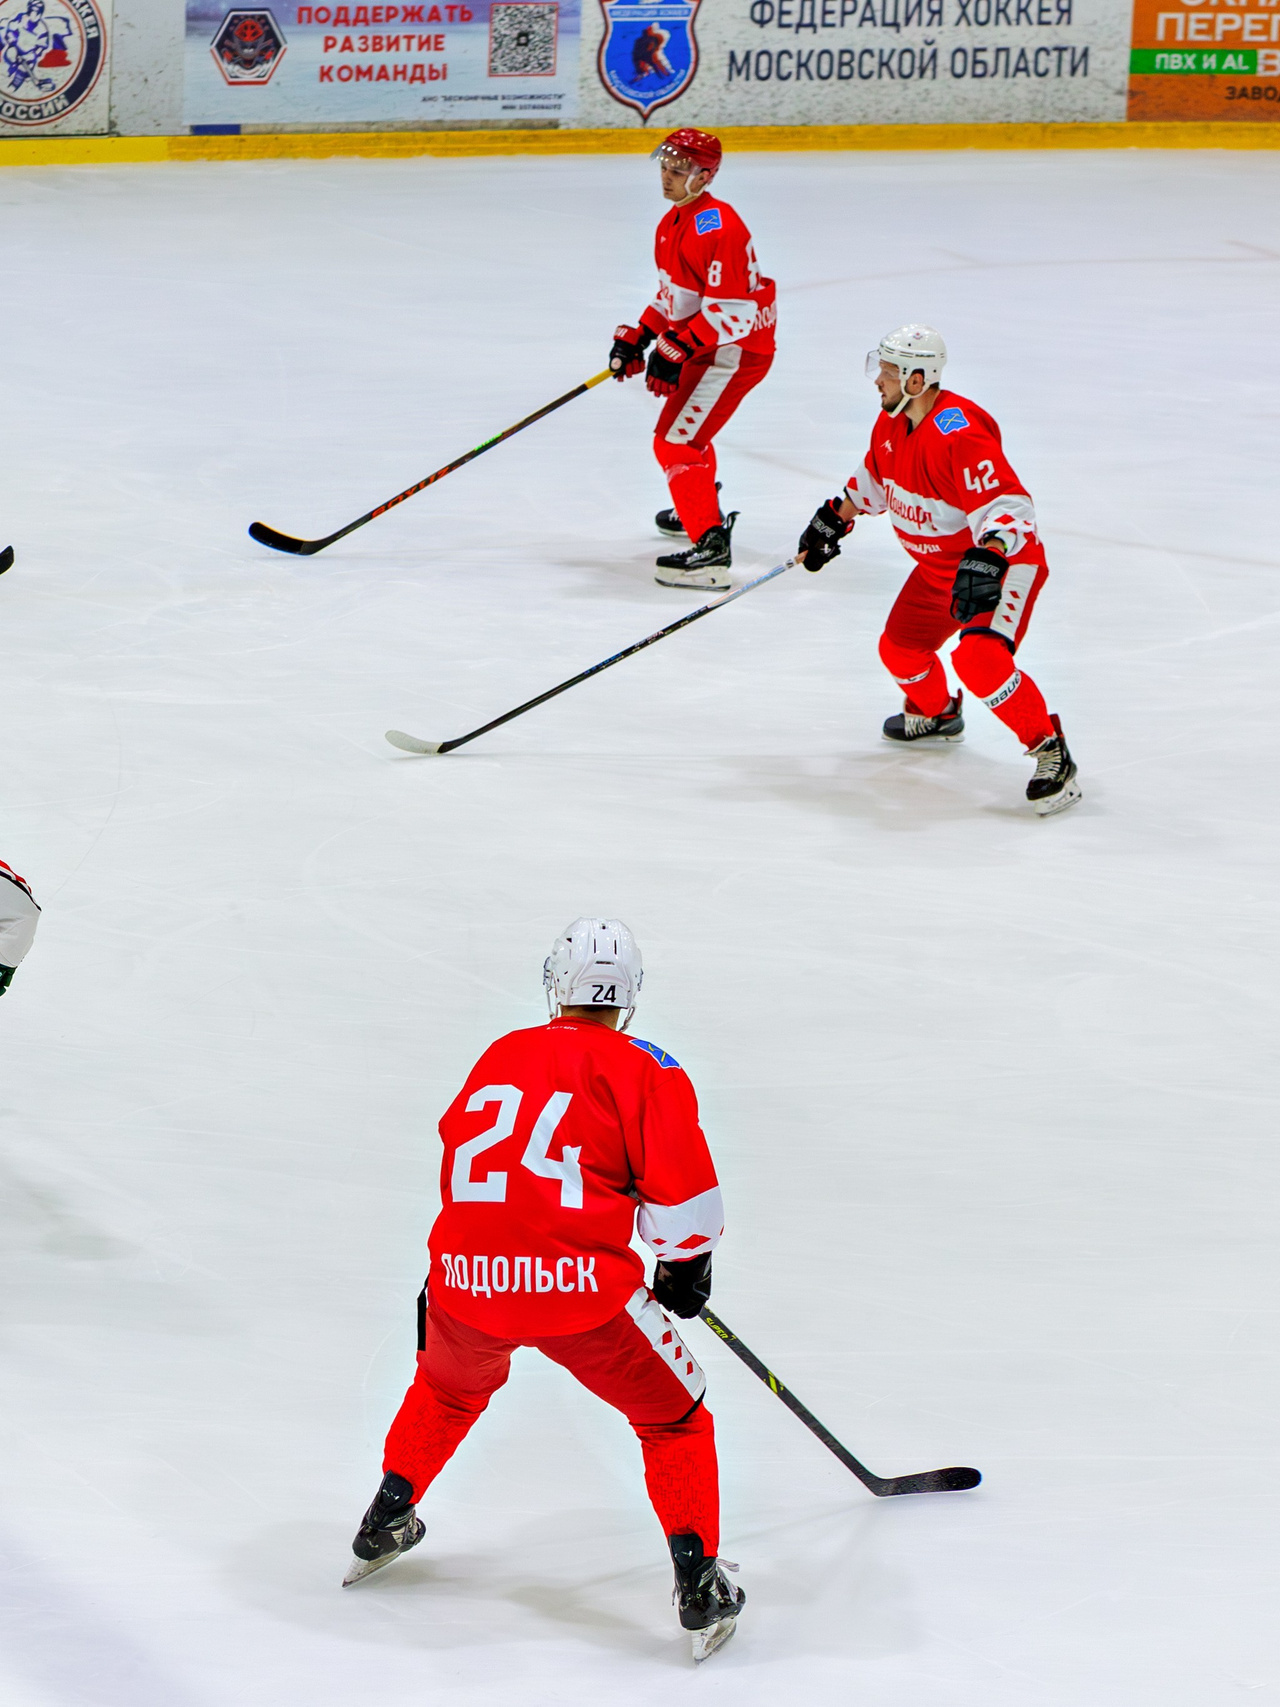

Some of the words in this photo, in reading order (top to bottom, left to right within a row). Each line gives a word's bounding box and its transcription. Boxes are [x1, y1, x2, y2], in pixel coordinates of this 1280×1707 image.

[297, 5, 474, 26] ПОДДЕРЖАТЬ
[750, 0, 943, 34] ФЕДЕРАЦИЯ
[954, 0, 1072, 26] ХОККЕЯ
[323, 34, 445, 52] РАЗВИТИЕ
[728, 39, 937, 81] МОСКОВСКОЙ
[950, 46, 1089, 78] ОБЛАСТИ
[1155, 53, 1197, 70] ПВХ
[1202, 53, 1217, 70] И
[319, 64, 447, 84] КОМАНДЫ
[1225, 86, 1280, 102] ЗАВО
[708, 260, 722, 287] 8
[963, 459, 1000, 494] 42
[592, 984, 617, 1003] 24
[451, 1084, 584, 1210] 24
[441, 1253, 599, 1298] ПОДОЛЬСК
